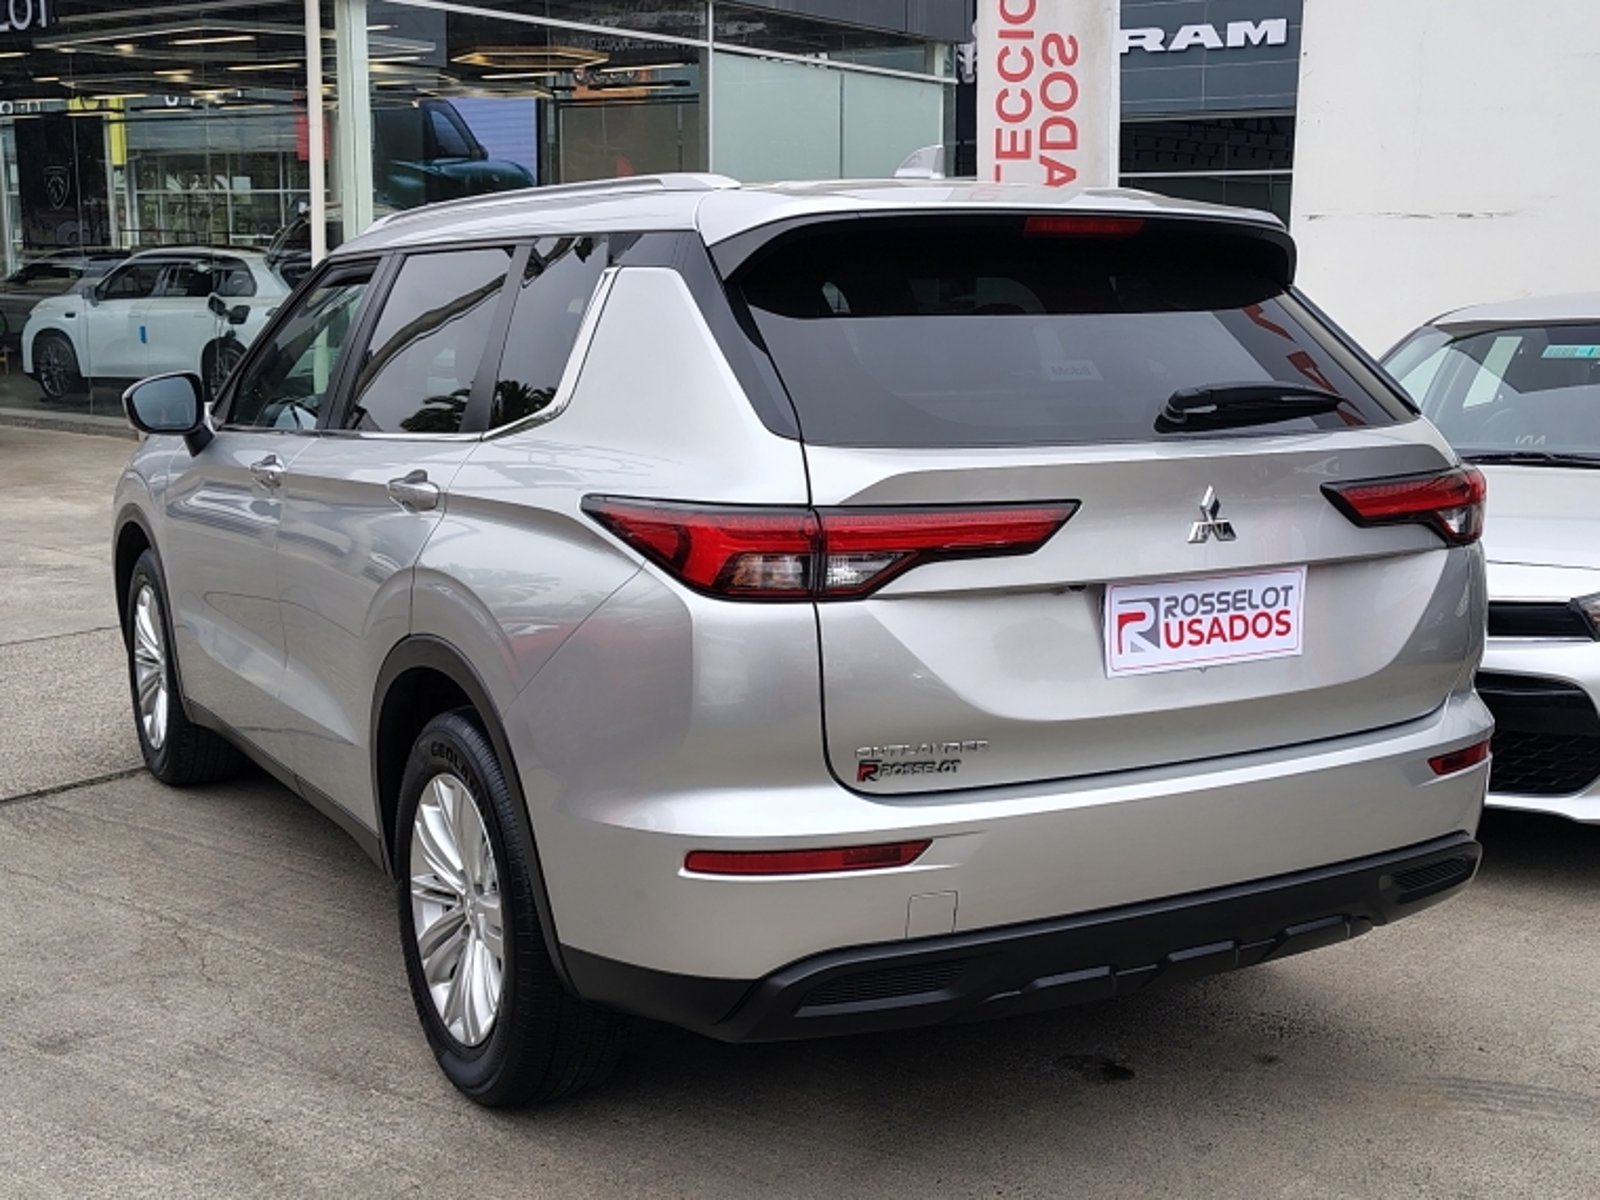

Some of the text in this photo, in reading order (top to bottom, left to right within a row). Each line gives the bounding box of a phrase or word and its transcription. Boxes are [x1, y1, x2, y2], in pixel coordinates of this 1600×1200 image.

[1120, 18, 1287, 53] RAM
[1164, 586, 1294, 620] ROSSELOT
[1164, 610, 1292, 649] USADOS
